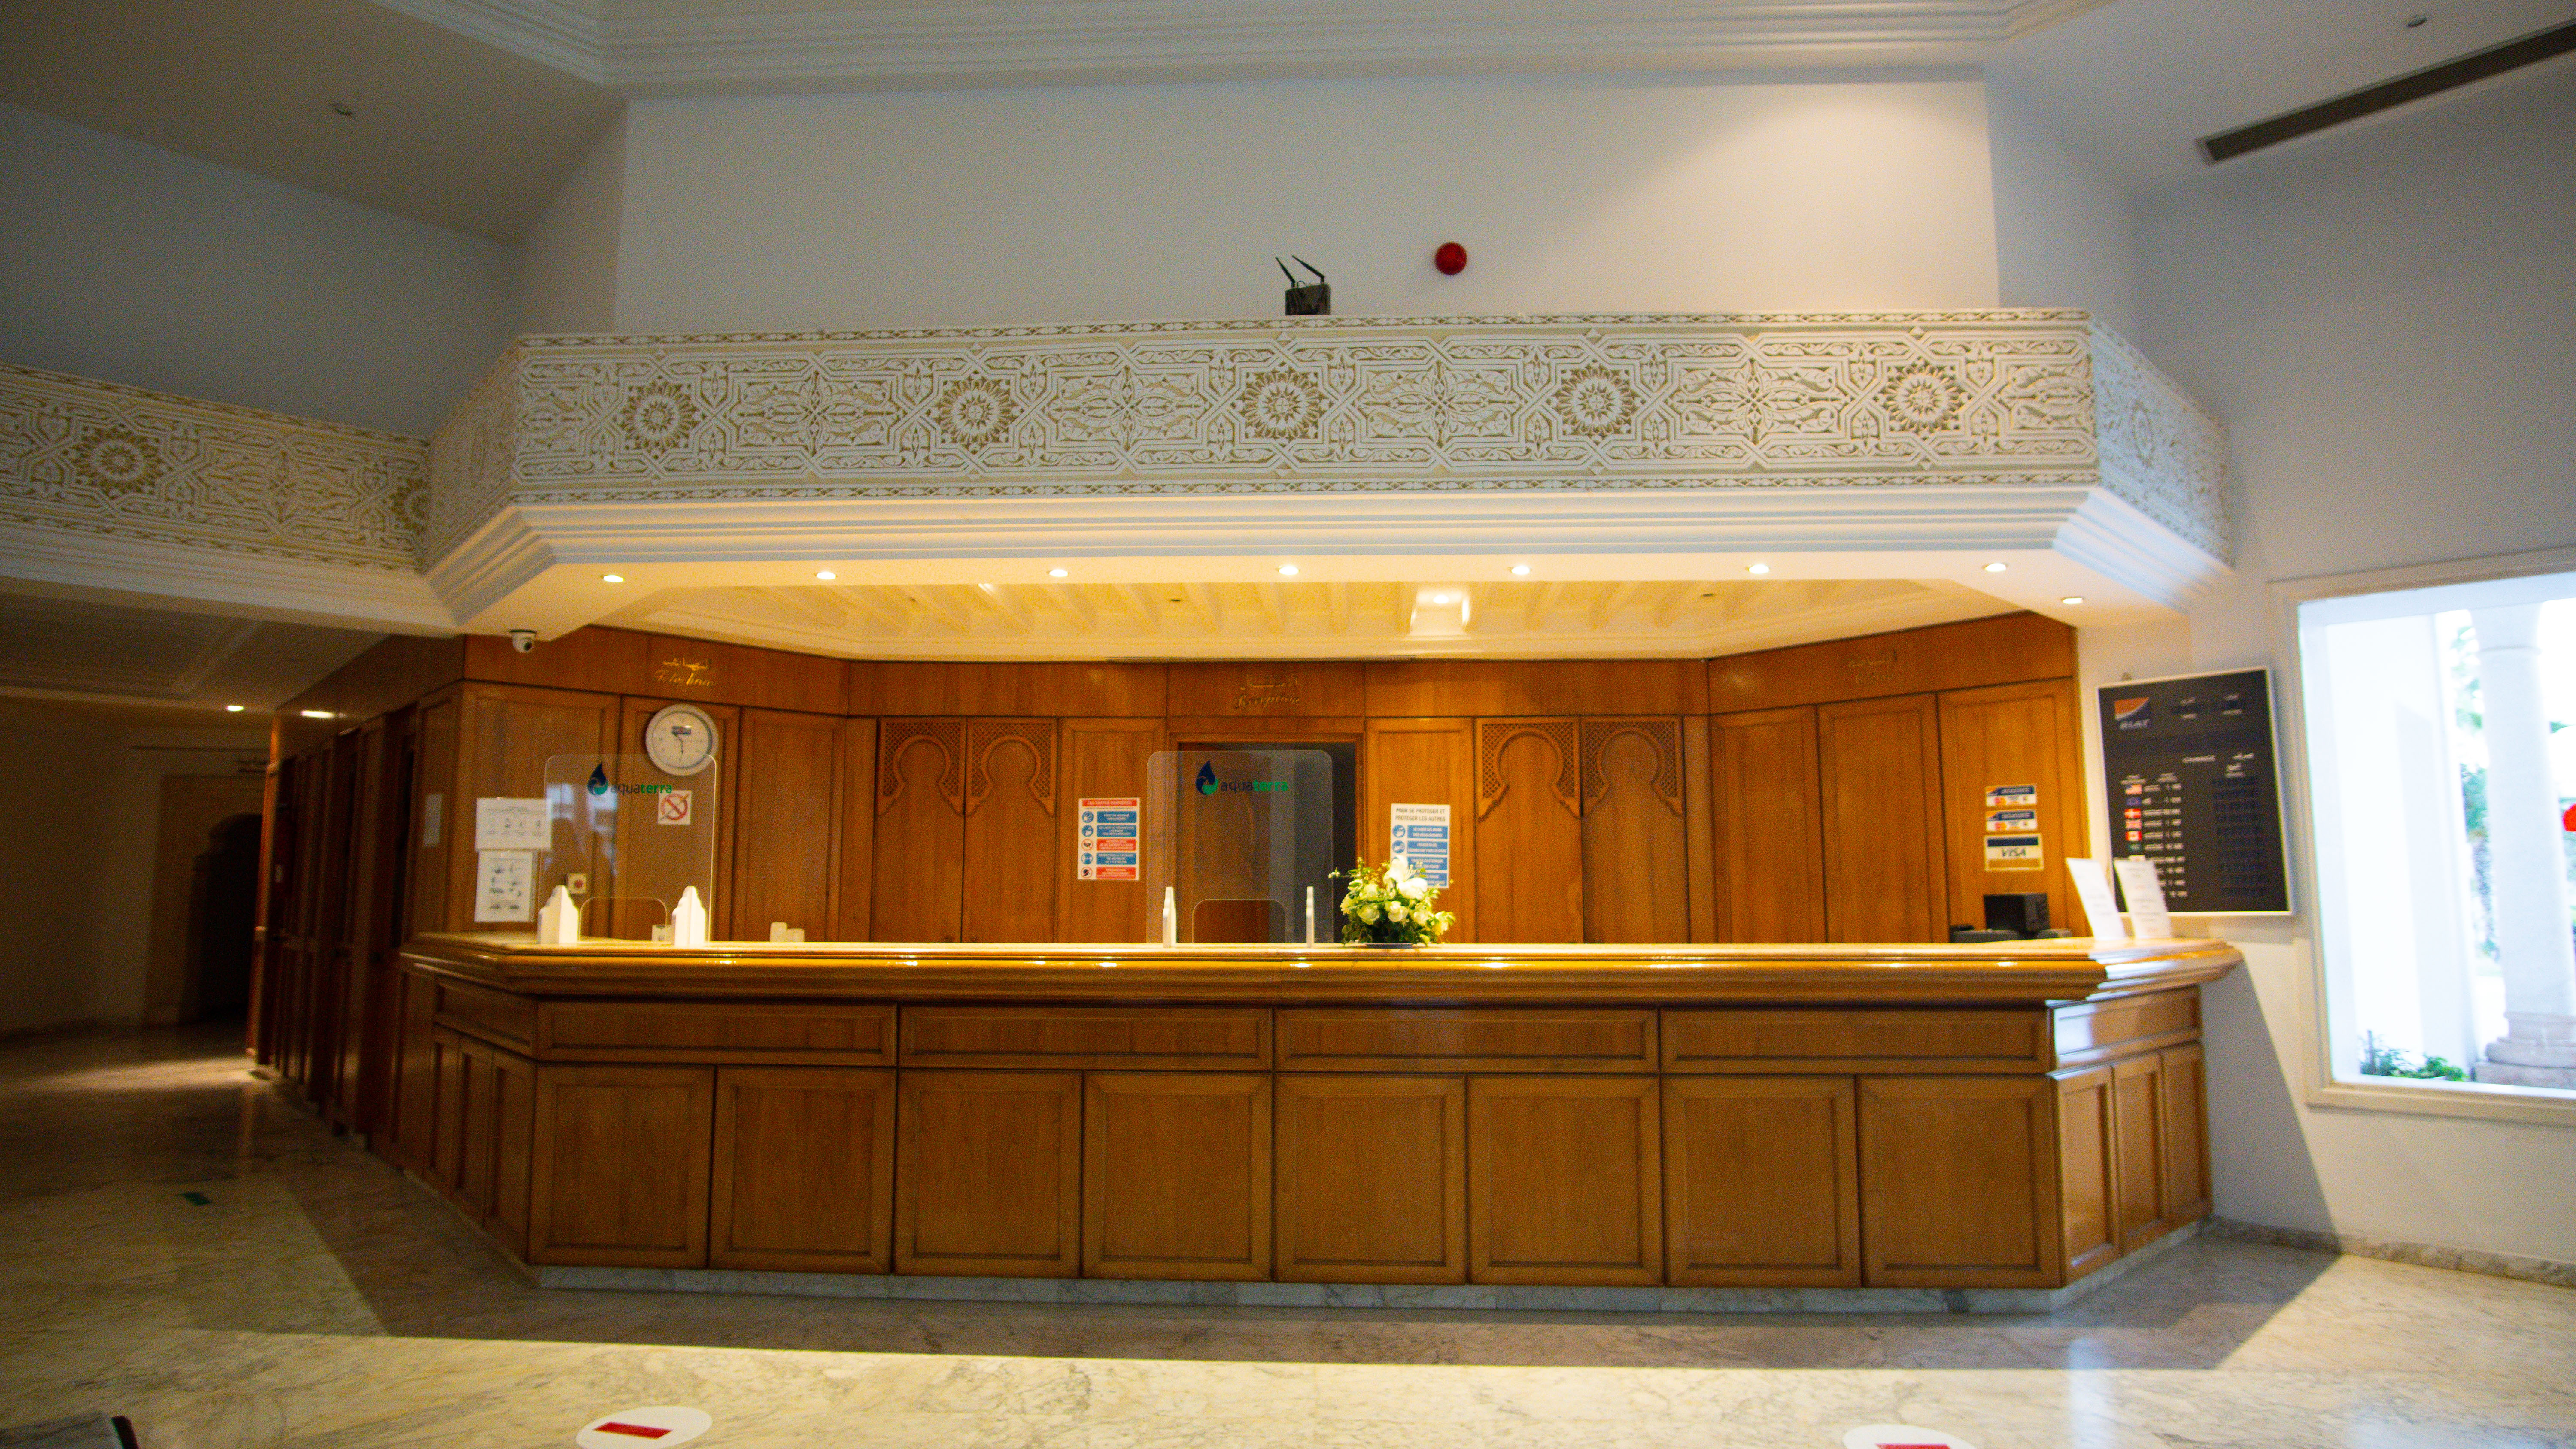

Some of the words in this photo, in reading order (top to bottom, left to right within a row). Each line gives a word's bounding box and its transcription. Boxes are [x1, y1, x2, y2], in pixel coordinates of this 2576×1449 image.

[2120, 719, 2149, 729] BIAT
[611, 784, 672, 795] aquaterra
[1220, 779, 1288, 794] aquaterra
[2002, 848, 2026, 856] VISA
